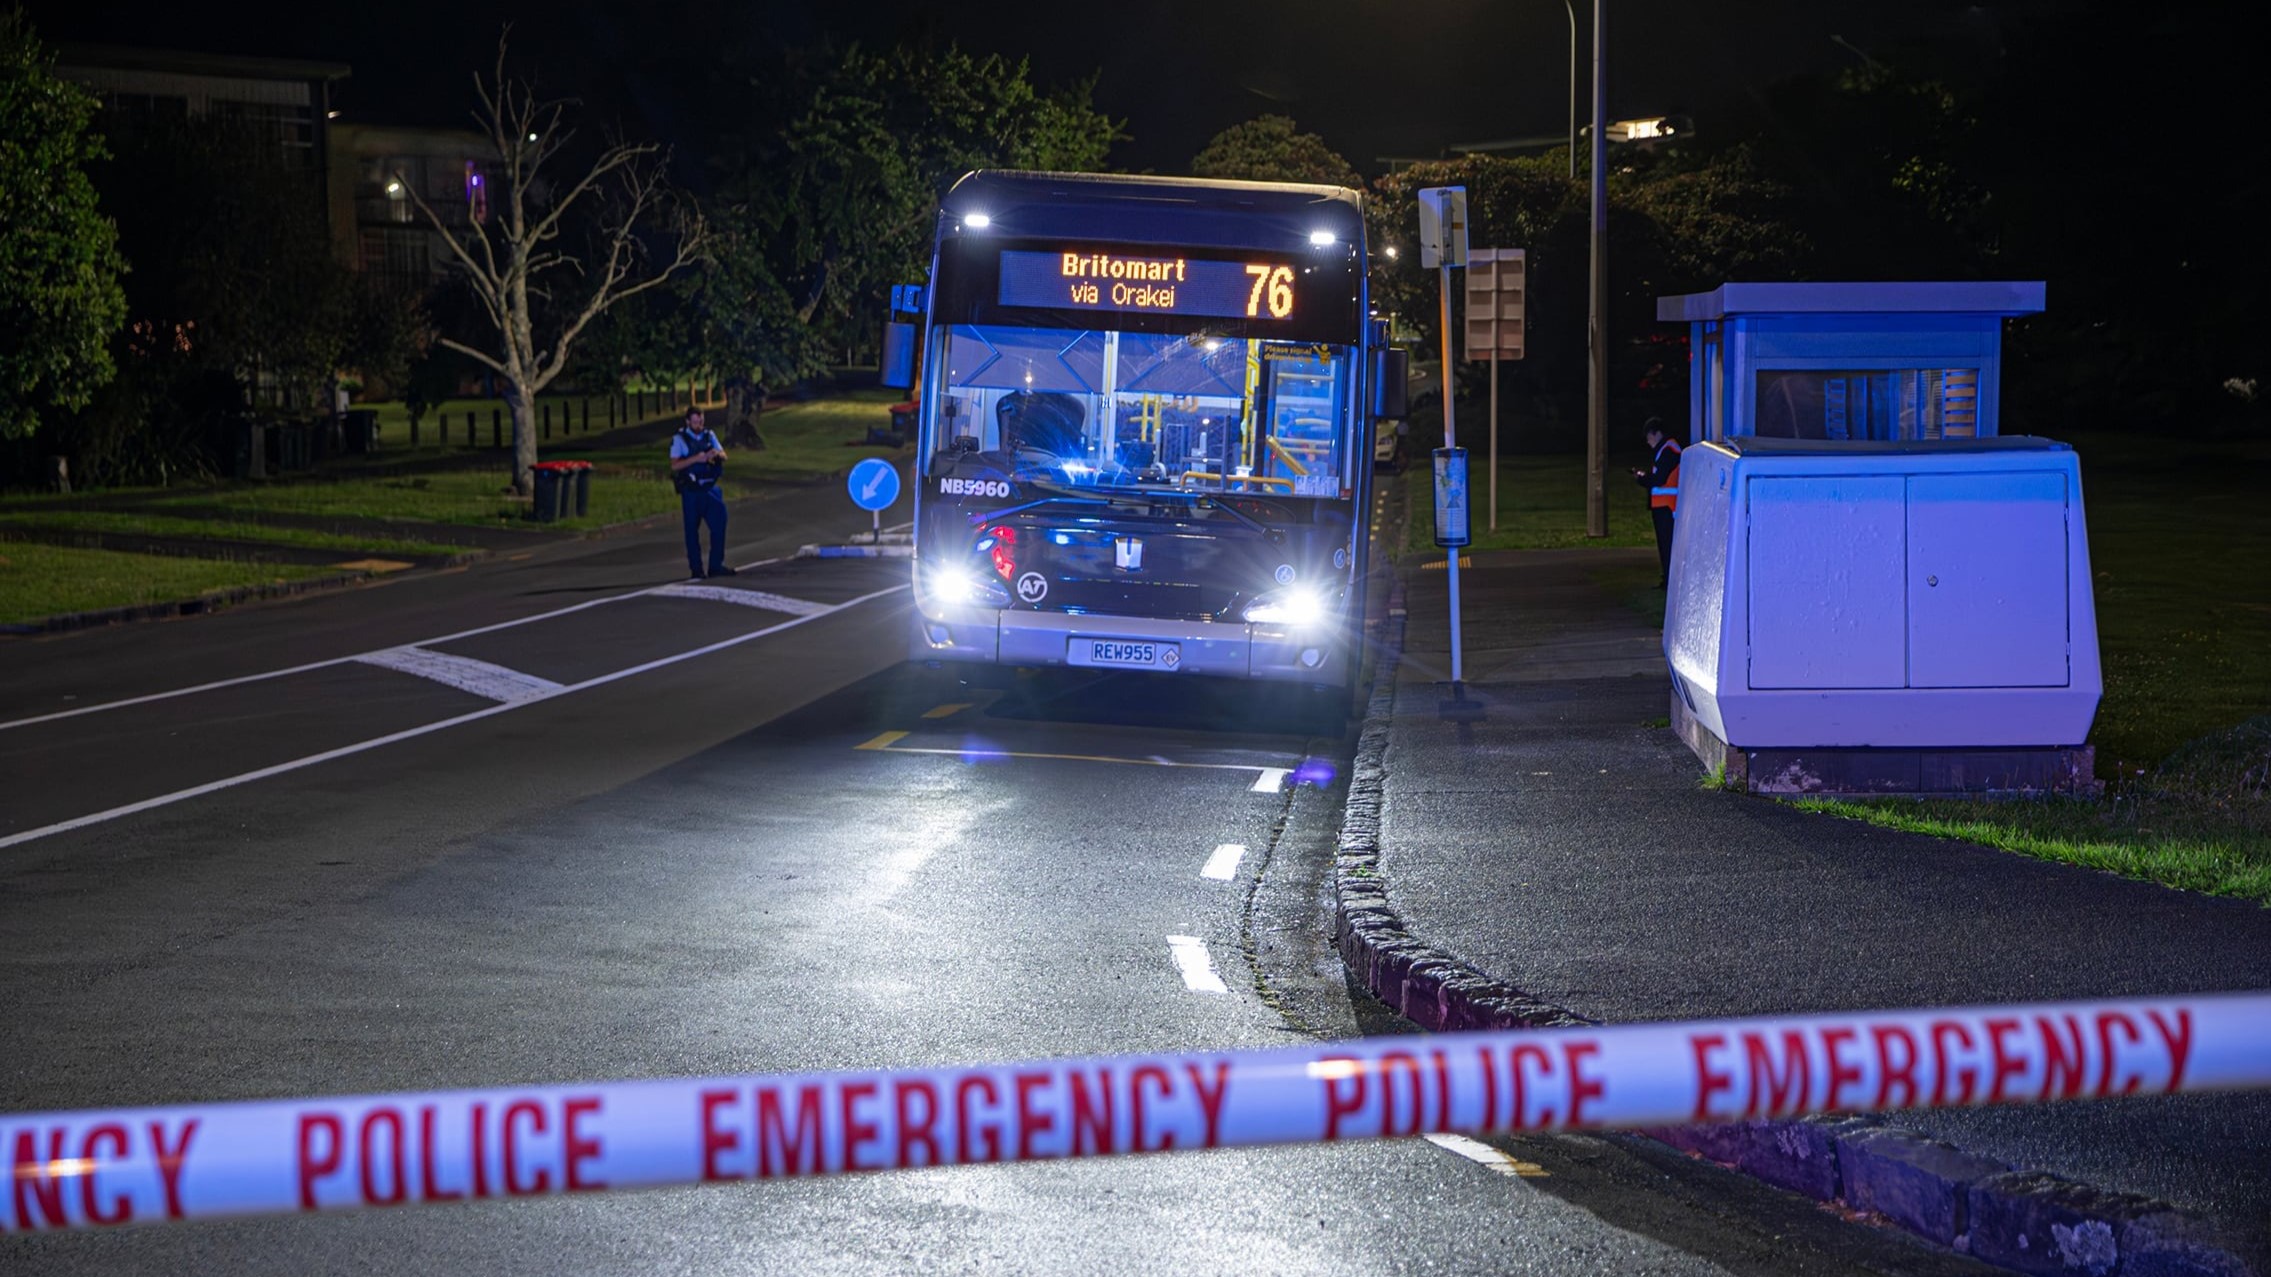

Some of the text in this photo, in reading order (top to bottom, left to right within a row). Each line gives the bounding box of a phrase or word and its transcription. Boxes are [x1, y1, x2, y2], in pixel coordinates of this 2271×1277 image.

[1062, 253, 1186, 282] Britomart
[1070, 281, 1175, 307] via Orakei
[1245, 265, 1294, 318] 76
[940, 478, 1010, 498] NB5960
[1094, 643, 1153, 661] REW955
[298, 1097, 609, 1210] POLICE
[700, 1059, 1232, 1182] EMERGENCY
[1322, 1040, 1605, 1141] POLICE
[1692, 1008, 2192, 1120] EMERGENCY
